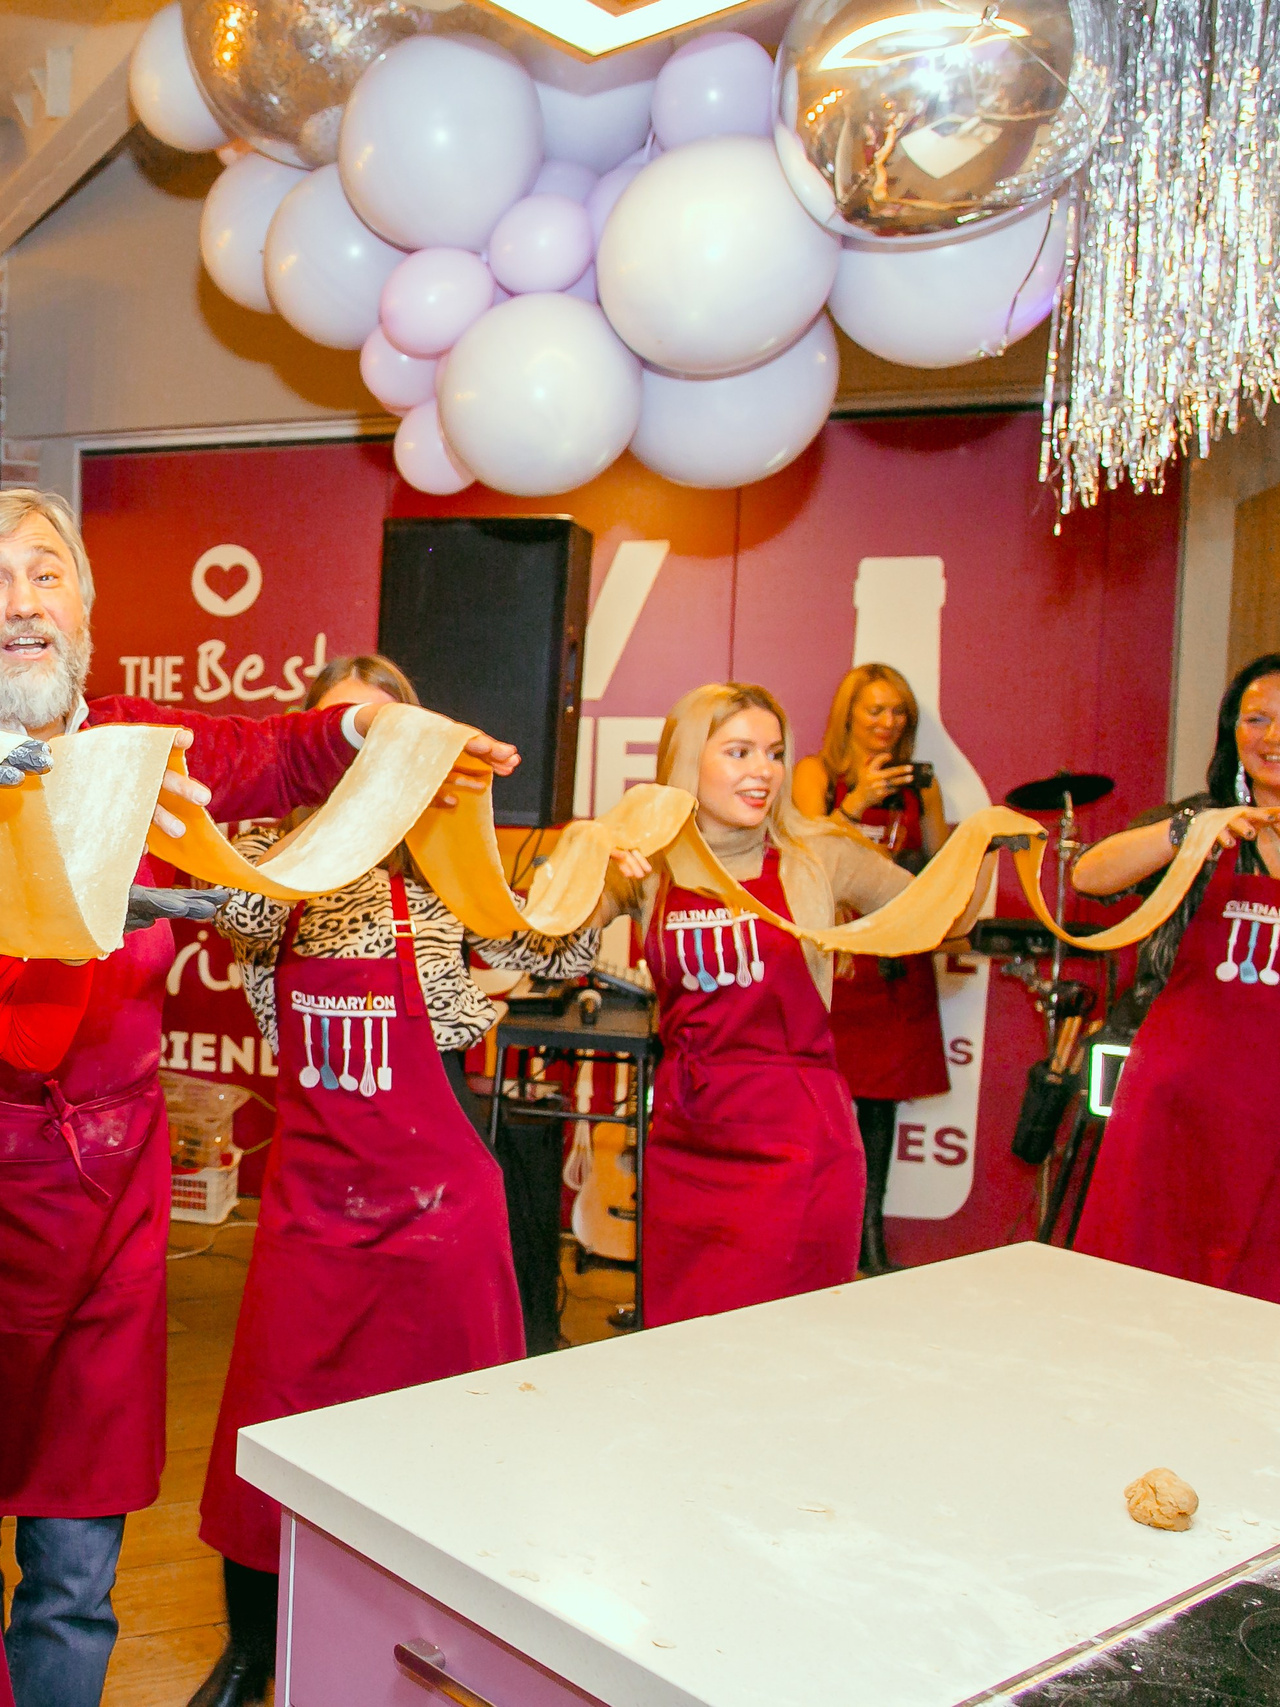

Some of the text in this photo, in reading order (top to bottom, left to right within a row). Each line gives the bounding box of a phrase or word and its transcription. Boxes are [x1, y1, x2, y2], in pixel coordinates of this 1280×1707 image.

[119, 632, 327, 702] THE Best
[1226, 900, 1280, 918] CULINA
